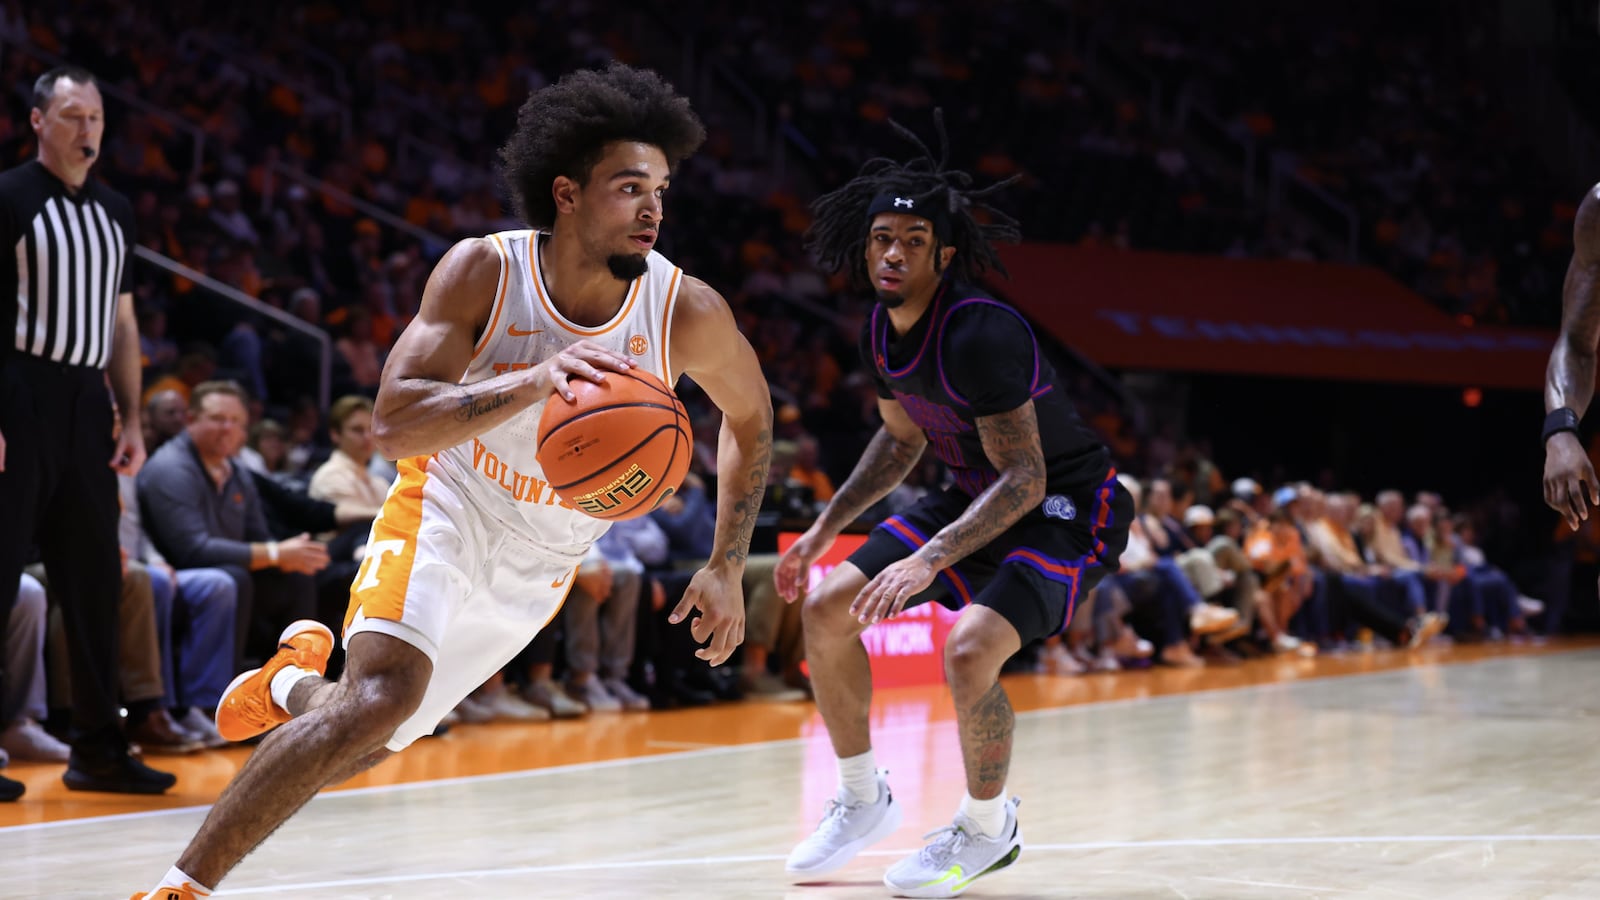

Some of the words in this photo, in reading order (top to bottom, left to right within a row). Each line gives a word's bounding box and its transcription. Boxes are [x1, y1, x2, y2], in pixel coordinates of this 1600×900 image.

[629, 336, 648, 354] SEC
[455, 392, 514, 421] Heather
[472, 437, 574, 510] VOLUNT
[576, 468, 653, 513] ELITE
